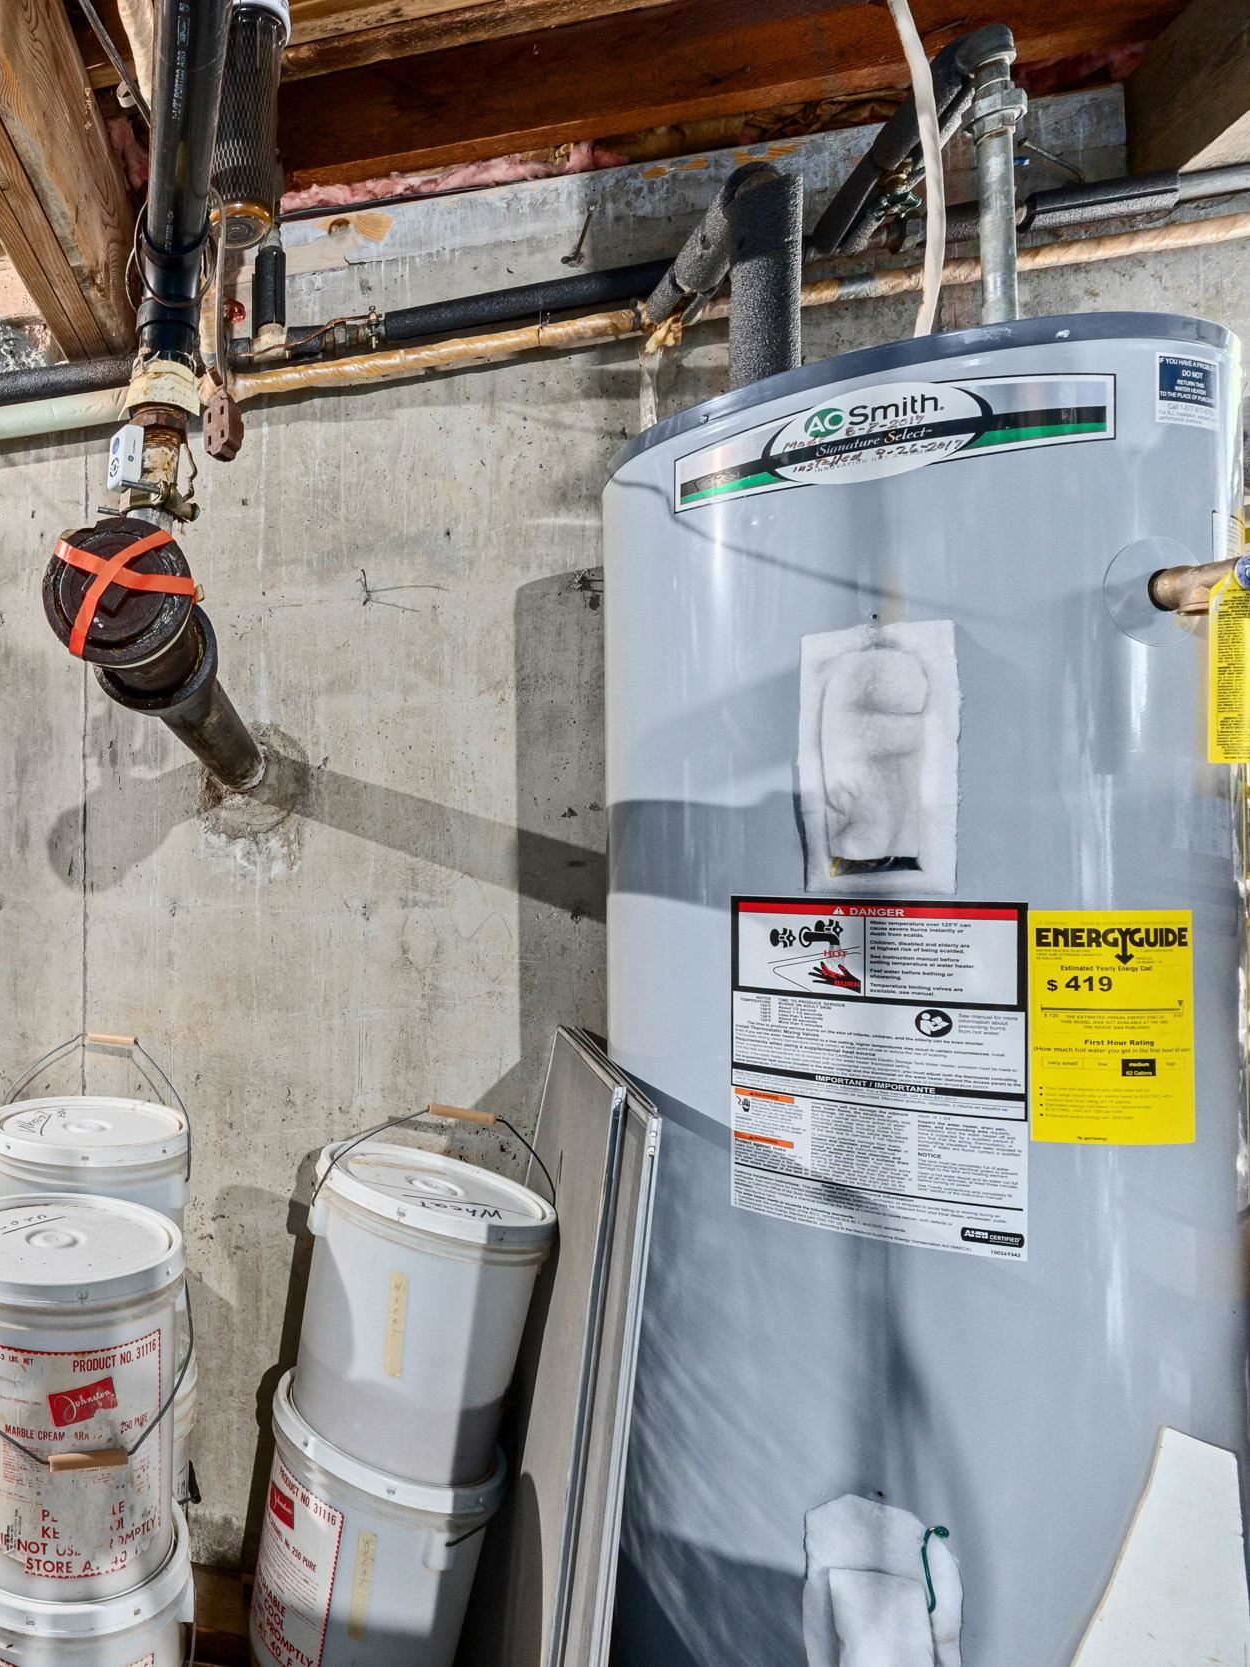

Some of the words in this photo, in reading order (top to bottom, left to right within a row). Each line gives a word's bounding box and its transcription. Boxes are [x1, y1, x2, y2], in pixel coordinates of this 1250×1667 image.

[1192, 371, 1203, 379] NOT
[816, 437, 881, 456] Signature
[884, 429, 928, 444] Select
[850, 908, 905, 917] DANGER
[1096, 965, 1116, 973] Yearly
[1118, 965, 1139, 973] Energy
[1047, 979, 1058, 992] $
[1065, 976, 1113, 992] 419
[1129, 1039, 1155, 1047] Rating
[815, 1075, 868, 1088] IMPORTANT
[874, 1082, 936, 1094] IMPORTANTE
[989, 1234, 1021, 1243] CERTIFIED
[23, 1357, 34, 1366] NET
[72, 1355, 116, 1373] PRODUCT
[120, 1351, 134, 1366] NO.
[136, 1338, 157, 1360] 31116
[53, 1389, 112, 1422] Johnston
[5, 1424, 34, 1440] MARBLE
[37, 1430, 66, 1441] CREAM
[120, 1420, 133, 1434] 250
[279, 1466, 299, 1497] PRODUCT
[301, 1492, 311, 1510] NO.
[314, 1503, 337, 1526] 31116
[16, 1540, 48, 1556] NOT
[26, 1558, 73, 1574] STORE
[291, 1546, 302, 1561] 250
[302, 1556, 317, 1573] PURE
[264, 1598, 285, 1632] COOL
[267, 1618, 313, 1667] PROMPTLY
